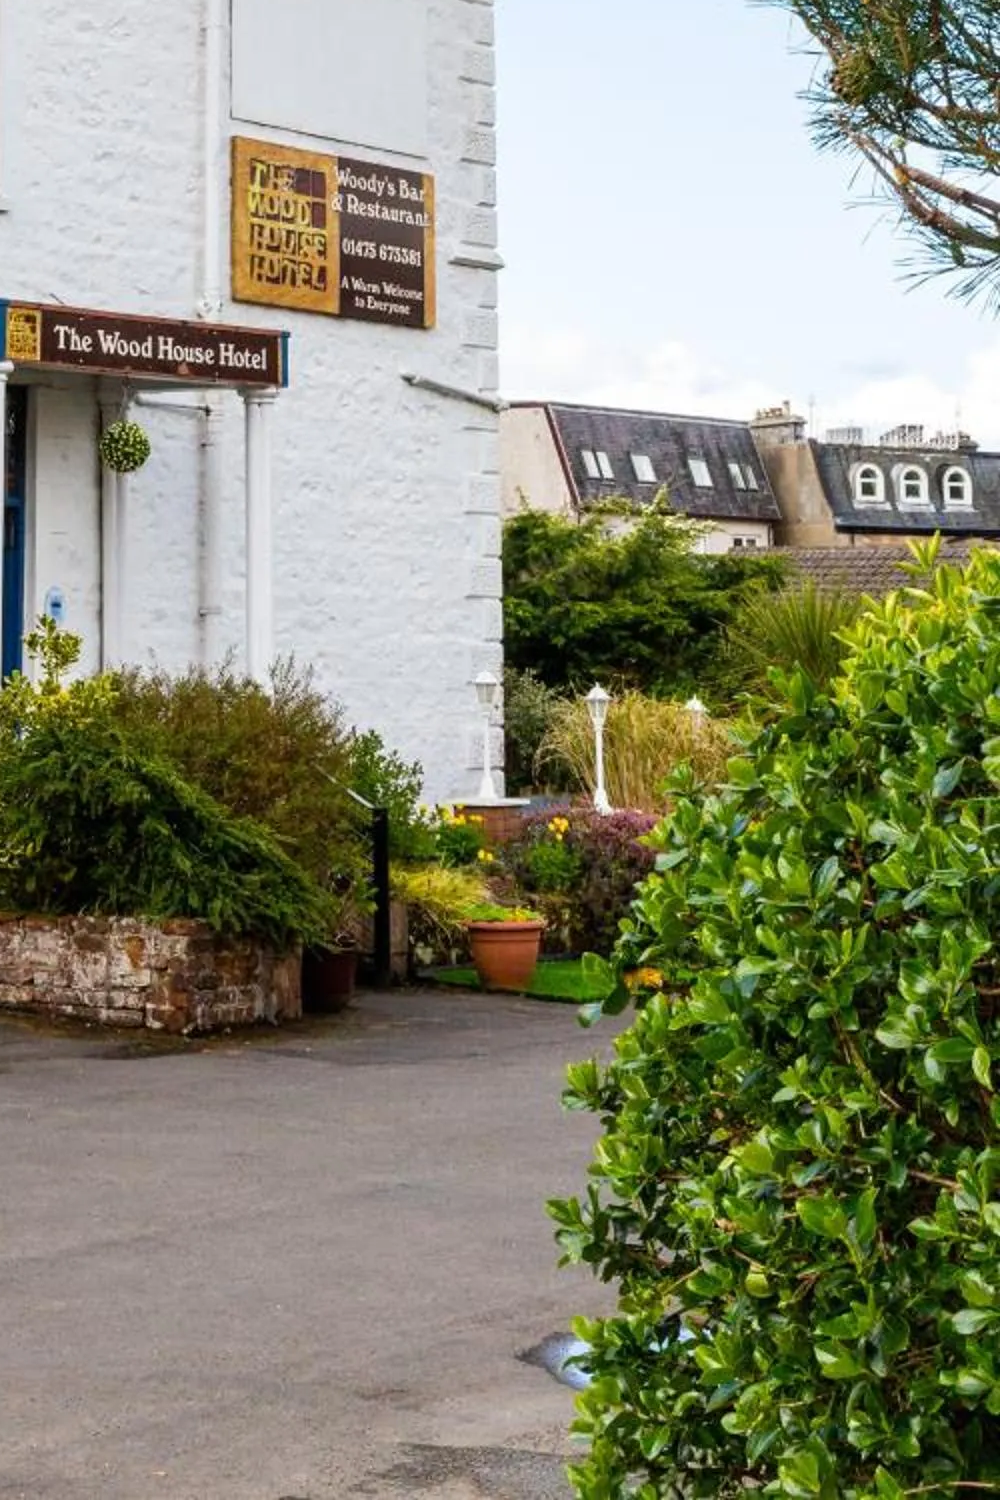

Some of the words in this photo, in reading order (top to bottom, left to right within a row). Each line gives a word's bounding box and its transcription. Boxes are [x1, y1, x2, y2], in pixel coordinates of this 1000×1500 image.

[250, 160, 296, 192] THE
[334, 166, 397, 197] Woody's
[399, 179, 425, 202] Bar
[248, 191, 312, 226] WOOD
[331, 192, 343, 212] &
[346, 193, 431, 227] Restaurant
[250, 222, 327, 261] HOUSE
[342, 238, 377, 259] 01475
[249, 254, 327, 292] HOTEL
[341, 275, 349, 289] A
[350, 276, 380, 294] Warm
[381, 281, 423, 300] Welcome
[354, 296, 365, 308] to
[367, 295, 411, 315] Everyone
[54, 325, 92, 351] The
[97, 330, 152, 358] Wood
[157, 336, 215, 364] House
[219, 343, 267, 370] Hotel
